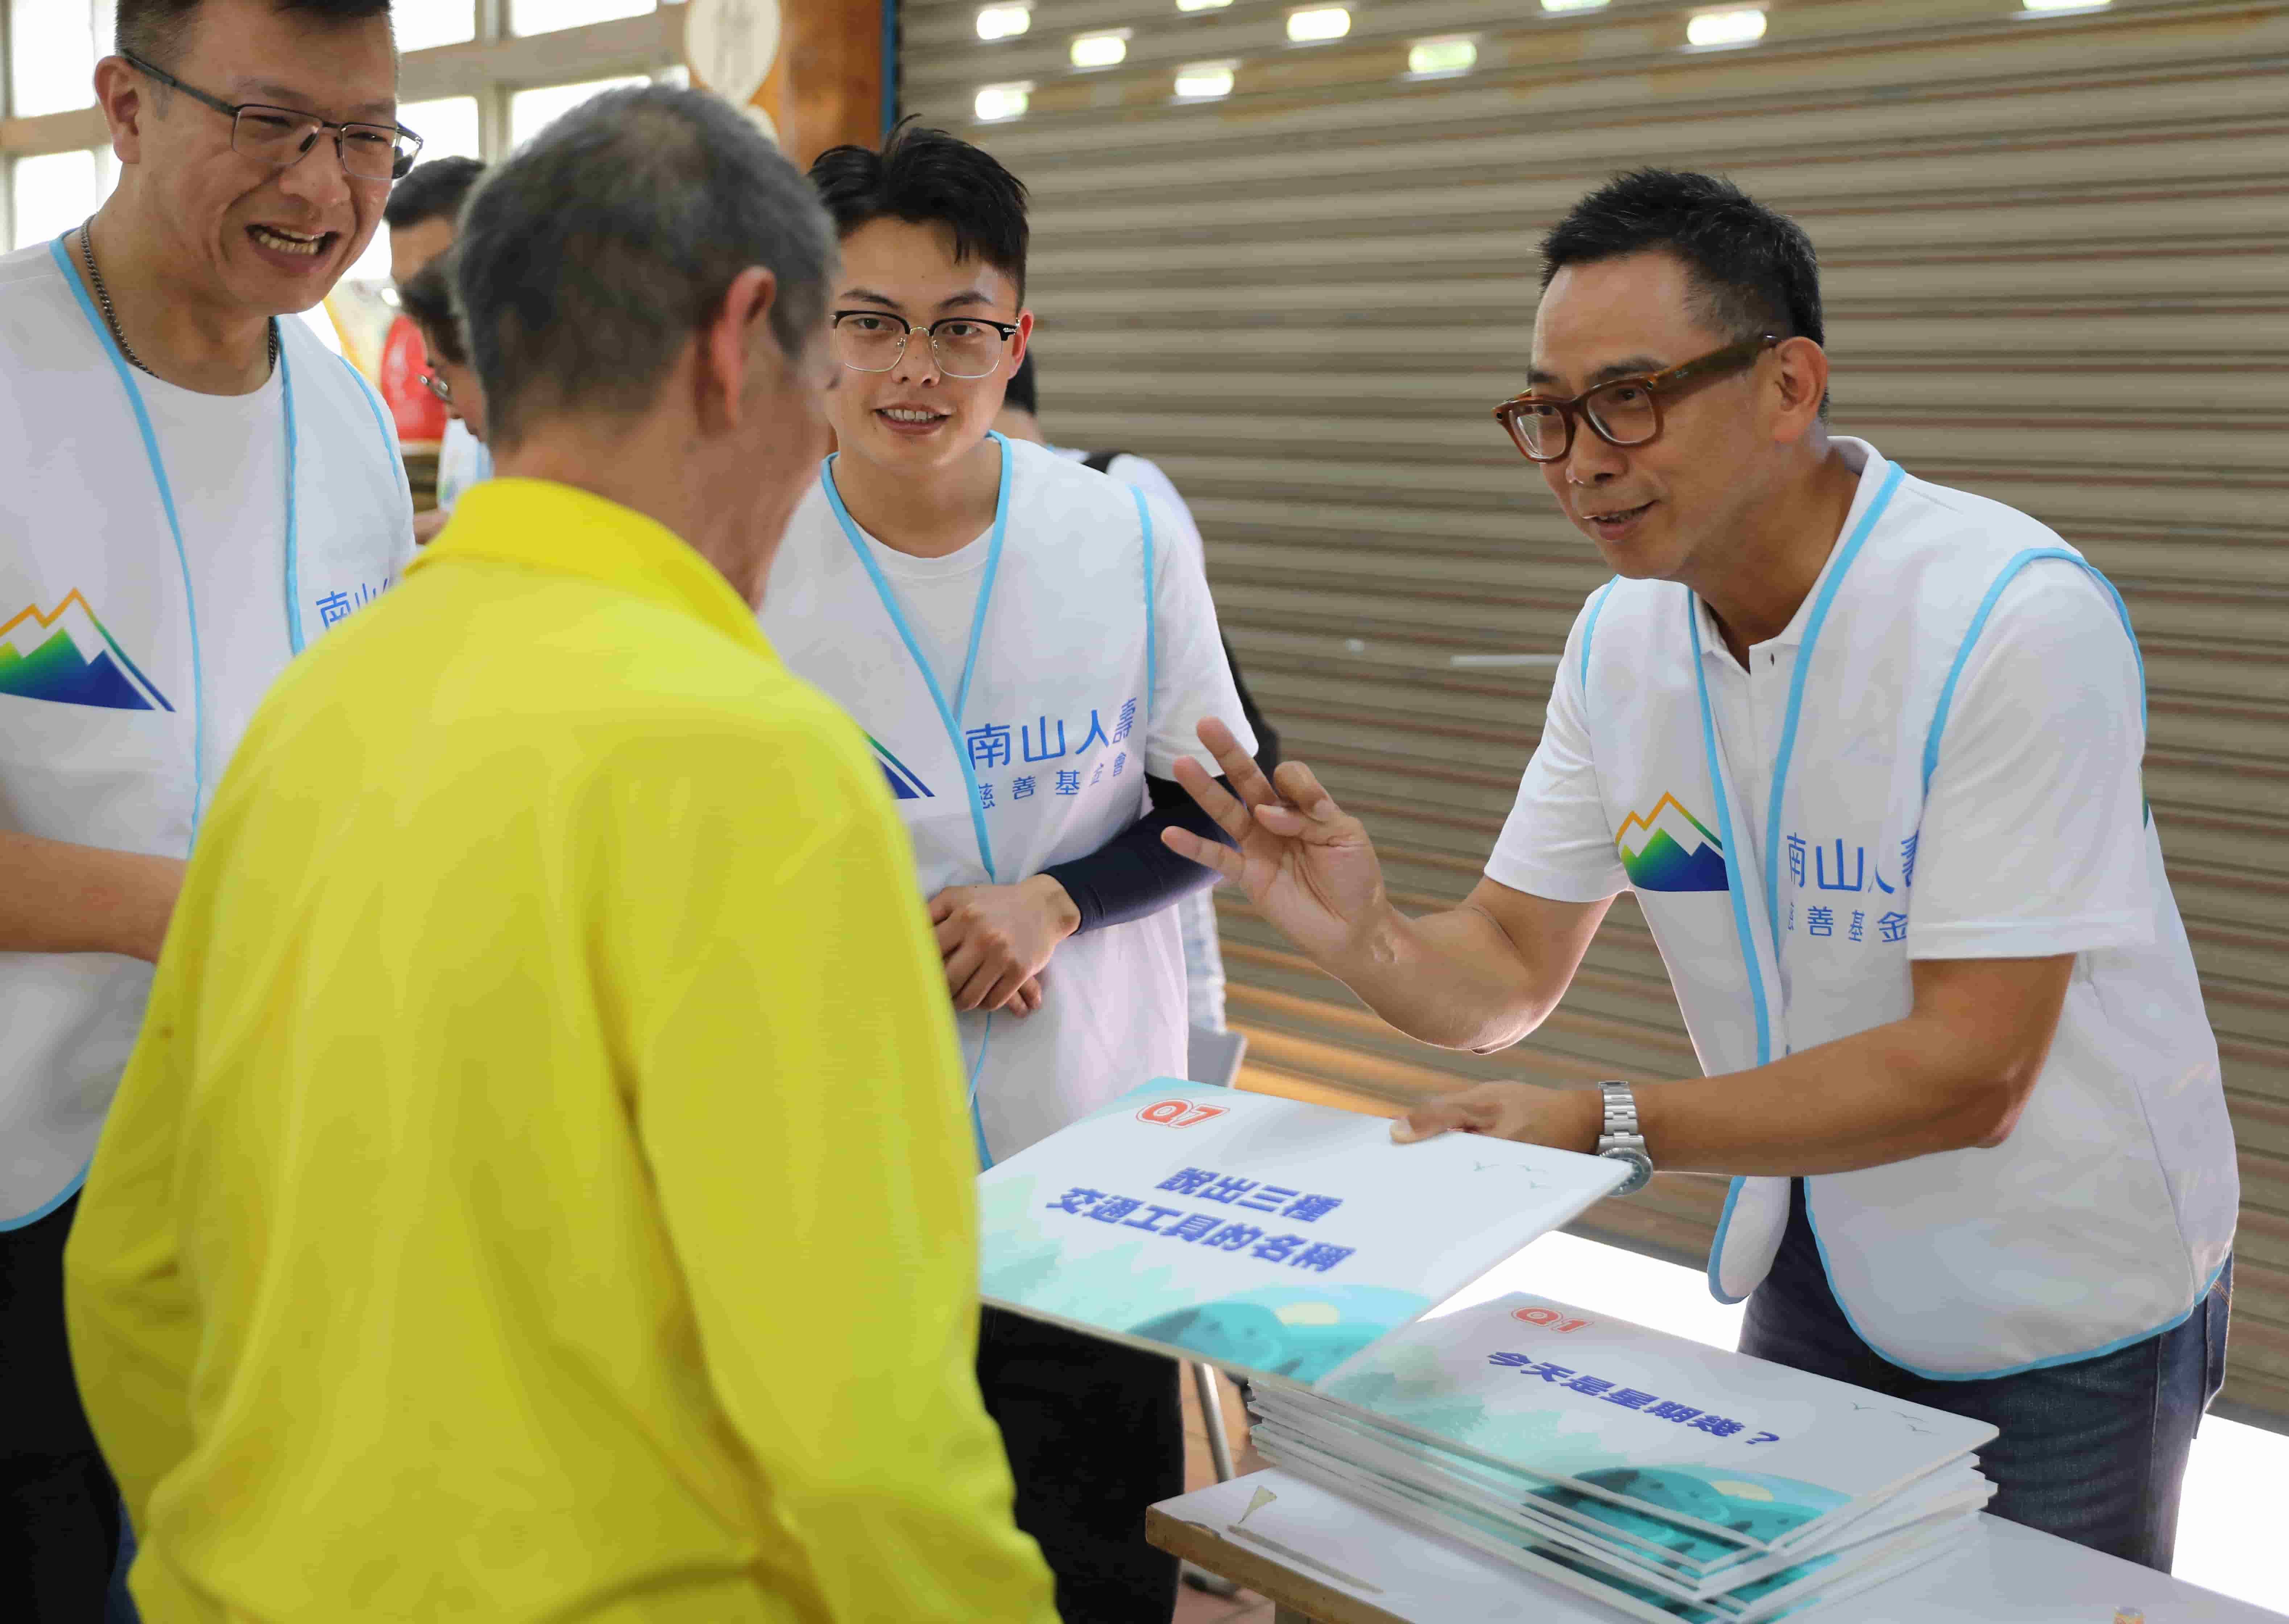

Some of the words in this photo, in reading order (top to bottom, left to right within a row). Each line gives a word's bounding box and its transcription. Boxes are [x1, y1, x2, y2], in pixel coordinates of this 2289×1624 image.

[965, 697, 1137, 770] 南山人壽
[1787, 901, 1908, 942] 善基金
[1136, 1098, 1230, 1128] Q7
[1154, 1167, 1343, 1222] 說出三種
[1046, 1187, 1357, 1272] 交通工具的名稱
[1511, 1307, 1594, 1333] Q1
